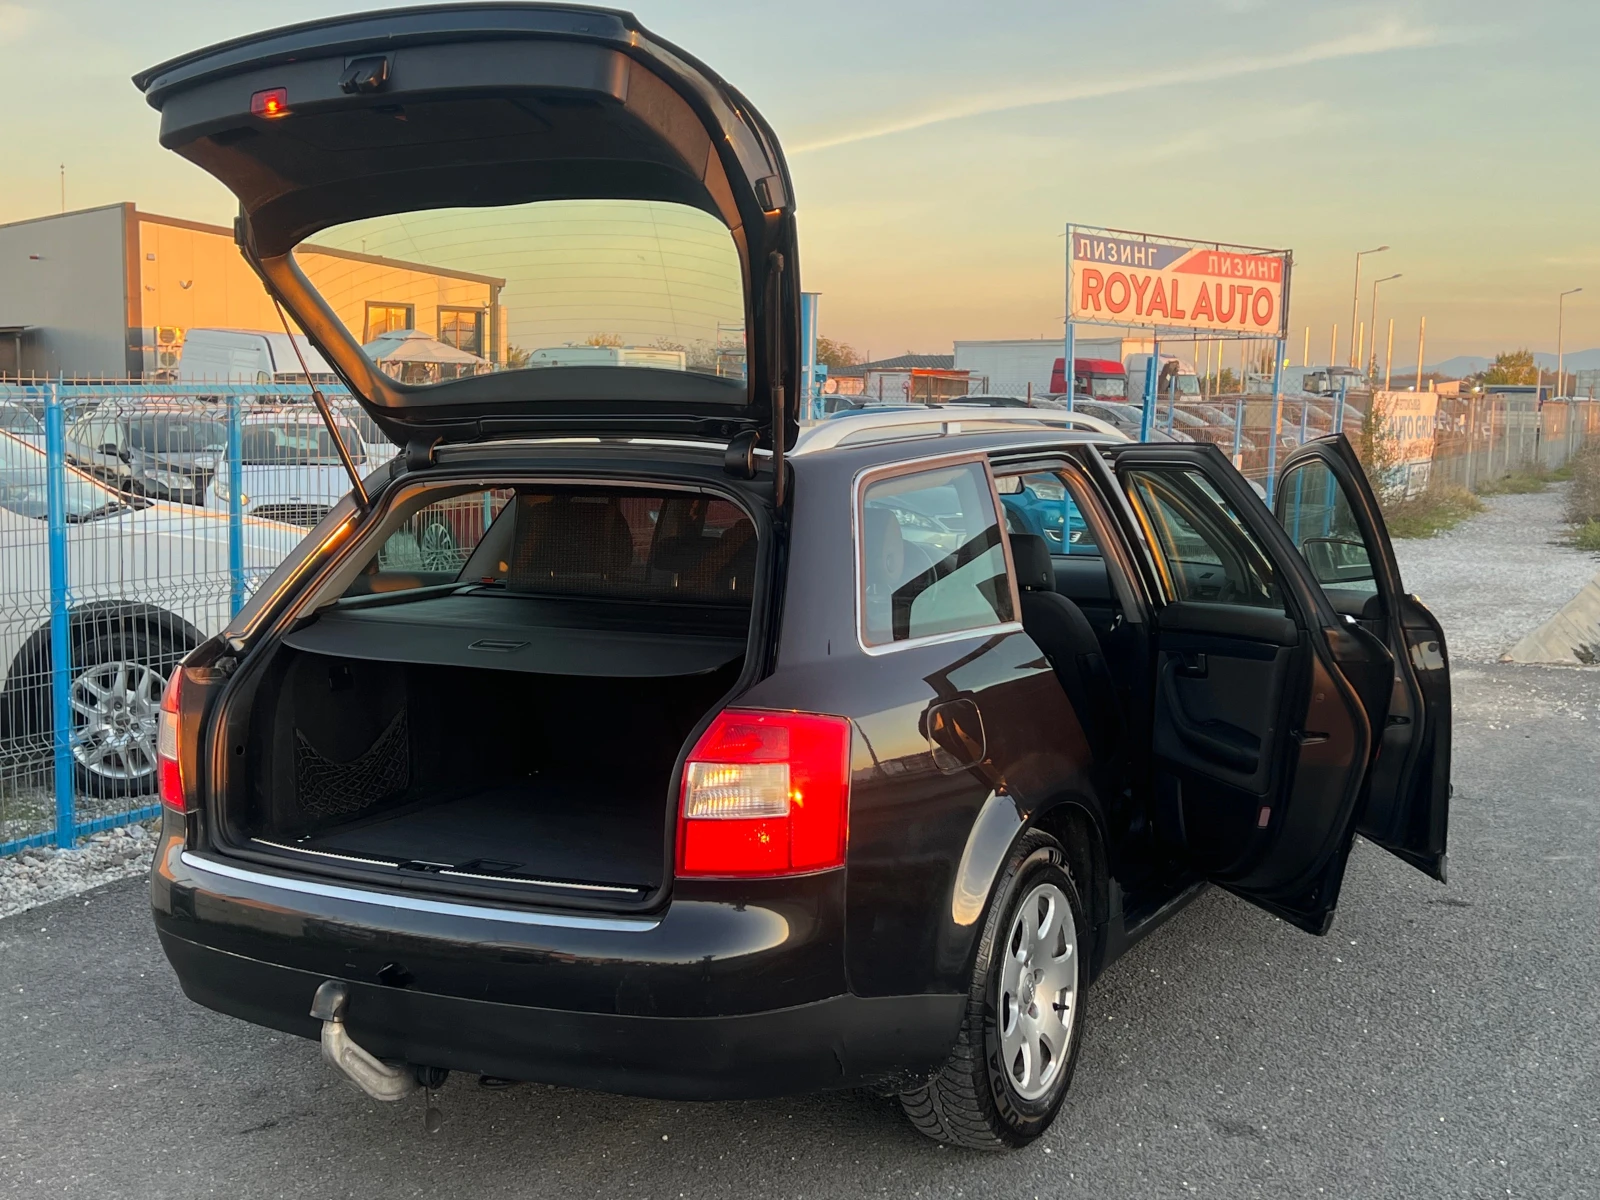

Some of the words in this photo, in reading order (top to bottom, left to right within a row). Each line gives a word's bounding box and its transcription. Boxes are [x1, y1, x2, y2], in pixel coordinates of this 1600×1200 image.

[1078, 239, 1157, 266] ЛИЗИНГ
[1208, 256, 1278, 279] ЛИЗИНГ
[1081, 268, 1186, 319] ROYAL
[1191, 281, 1274, 326] AUTO
